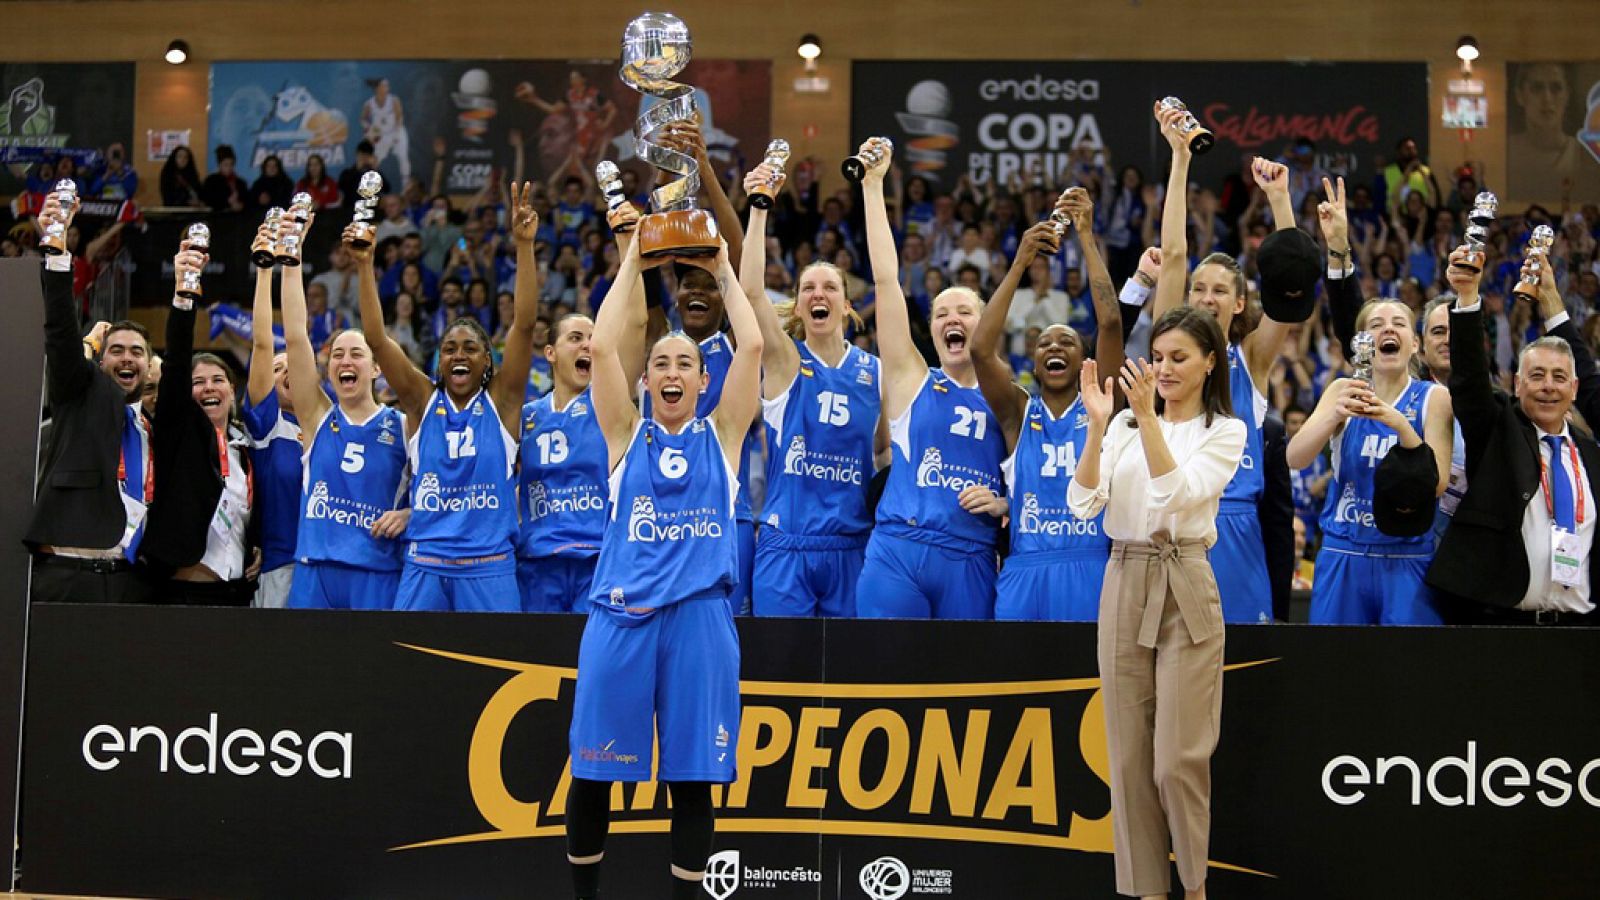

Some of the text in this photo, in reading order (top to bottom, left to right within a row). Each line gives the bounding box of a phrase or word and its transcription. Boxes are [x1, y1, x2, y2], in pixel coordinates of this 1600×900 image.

[980, 74, 1099, 100] endesa
[978, 113, 1103, 150] COPA
[817, 390, 850, 426] 15
[950, 406, 987, 440] 21
[340, 442, 365, 473] 5
[446, 426, 476, 459] 12
[536, 430, 569, 465] 13
[1041, 441, 1077, 477] 24
[659, 447, 688, 479] 6
[316, 499, 377, 529] avenid
[82, 712, 353, 779] endesa
[744, 866, 822, 882] baloncesto
[912, 877, 951, 887] MUJER
